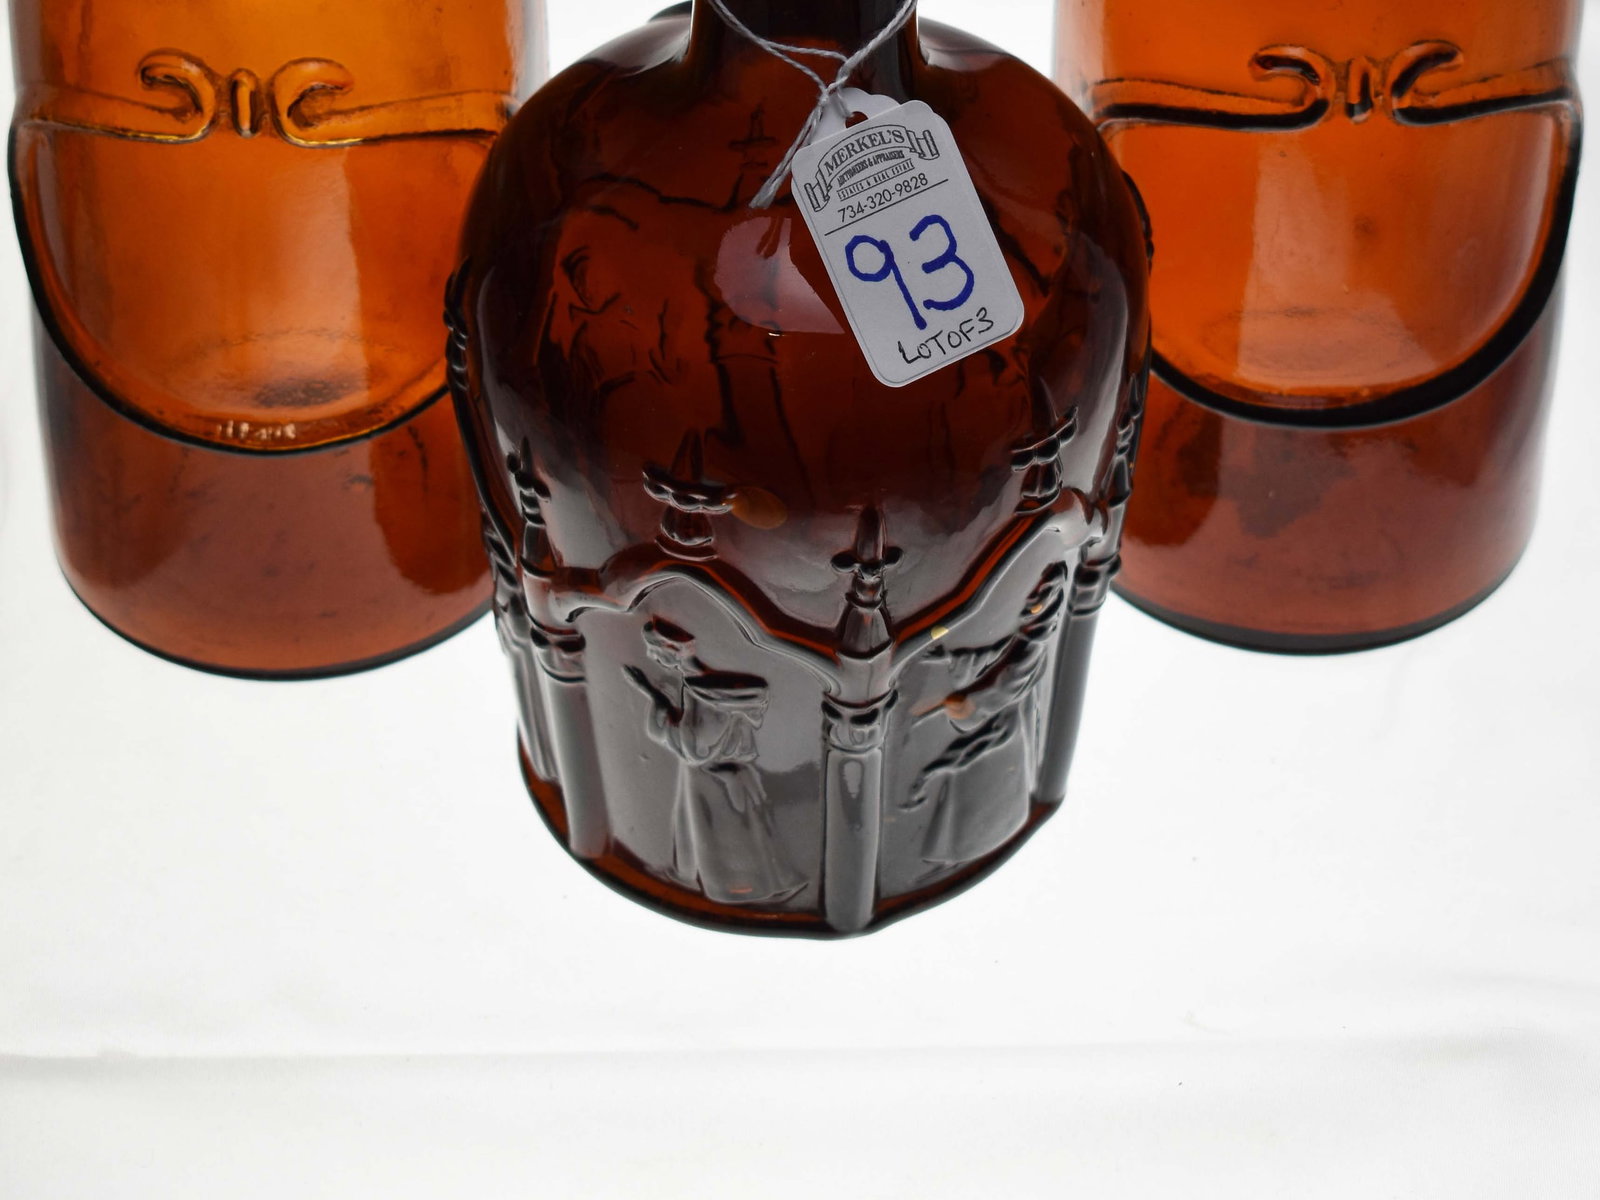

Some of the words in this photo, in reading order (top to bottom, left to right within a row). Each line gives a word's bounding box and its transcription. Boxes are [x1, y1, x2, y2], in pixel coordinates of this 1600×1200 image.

[823, 129, 905, 177] MERKEL'S
[872, 150, 905, 165] APPRAISERS
[873, 171, 890, 184] REAL
[891, 160, 914, 176] ESTATE
[837, 172, 928, 223] 734-320-9828
[845, 215, 974, 330] 93
